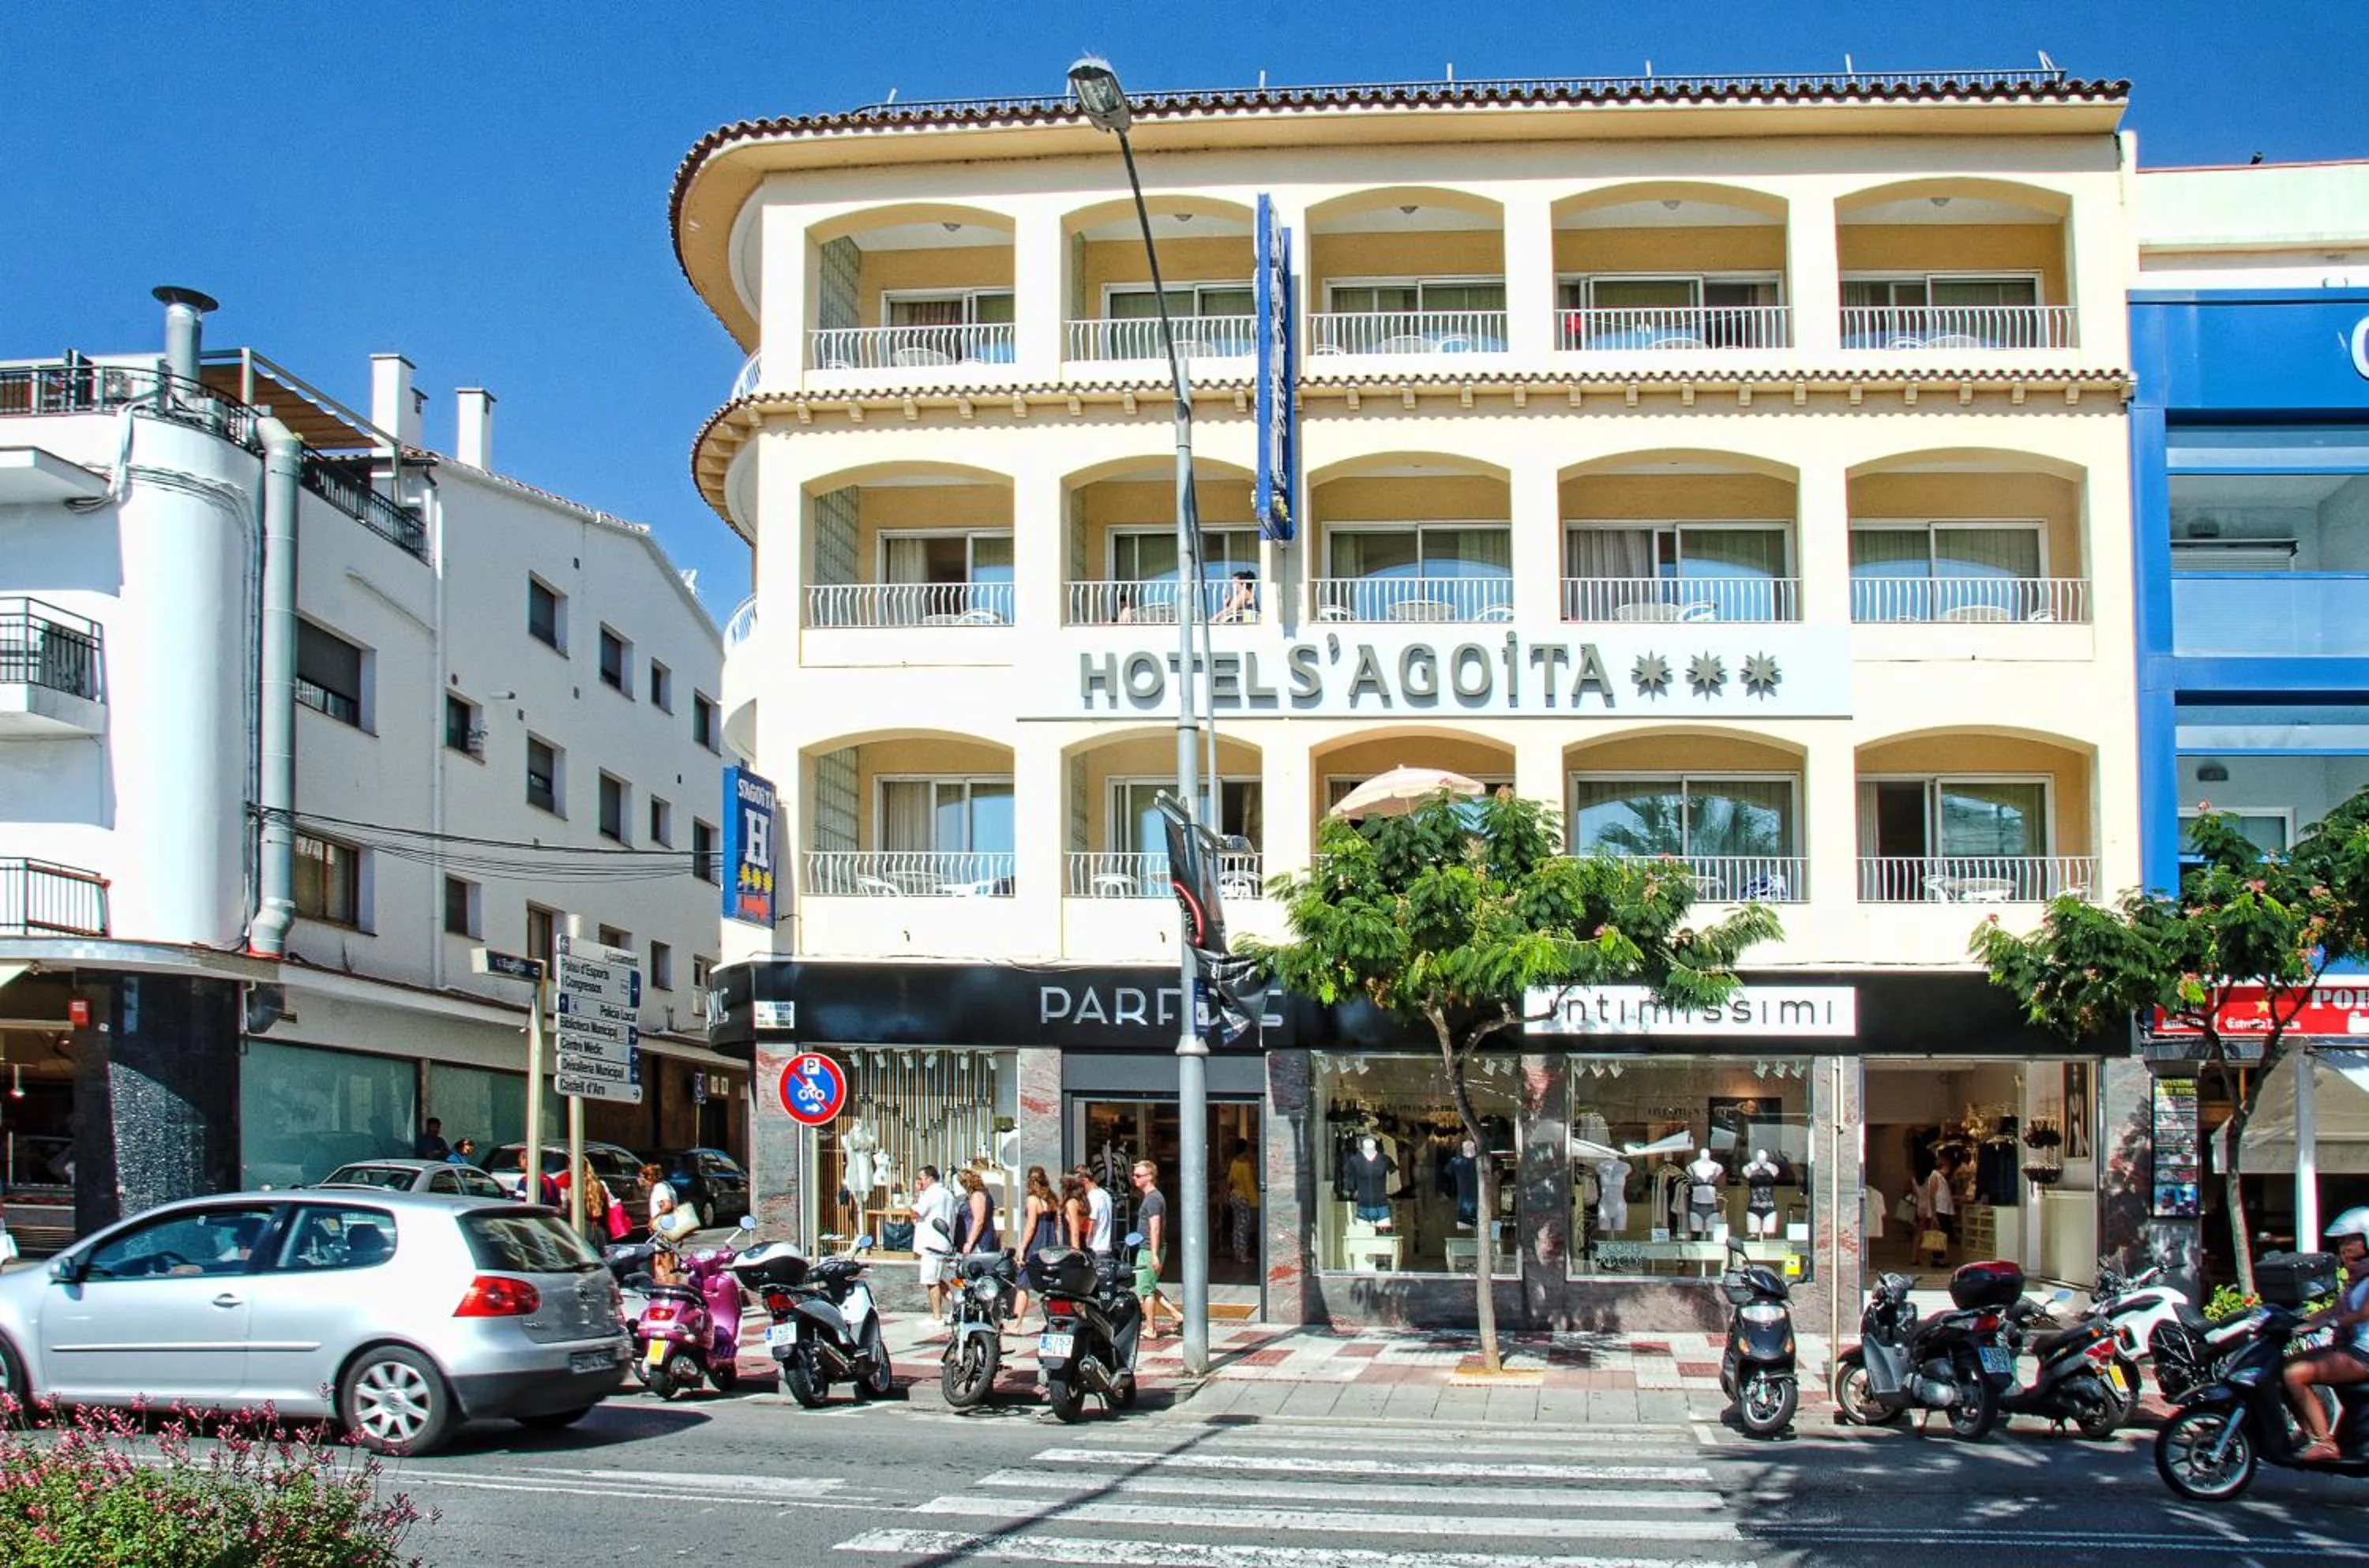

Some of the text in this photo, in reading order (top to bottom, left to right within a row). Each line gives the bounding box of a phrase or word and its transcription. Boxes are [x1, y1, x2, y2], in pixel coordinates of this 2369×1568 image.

[1080, 651, 1277, 697] HOTEL
[745, 808, 769, 868] H
[1039, 985, 1283, 1026] PARFS
[806, 1059, 816, 1073] P
